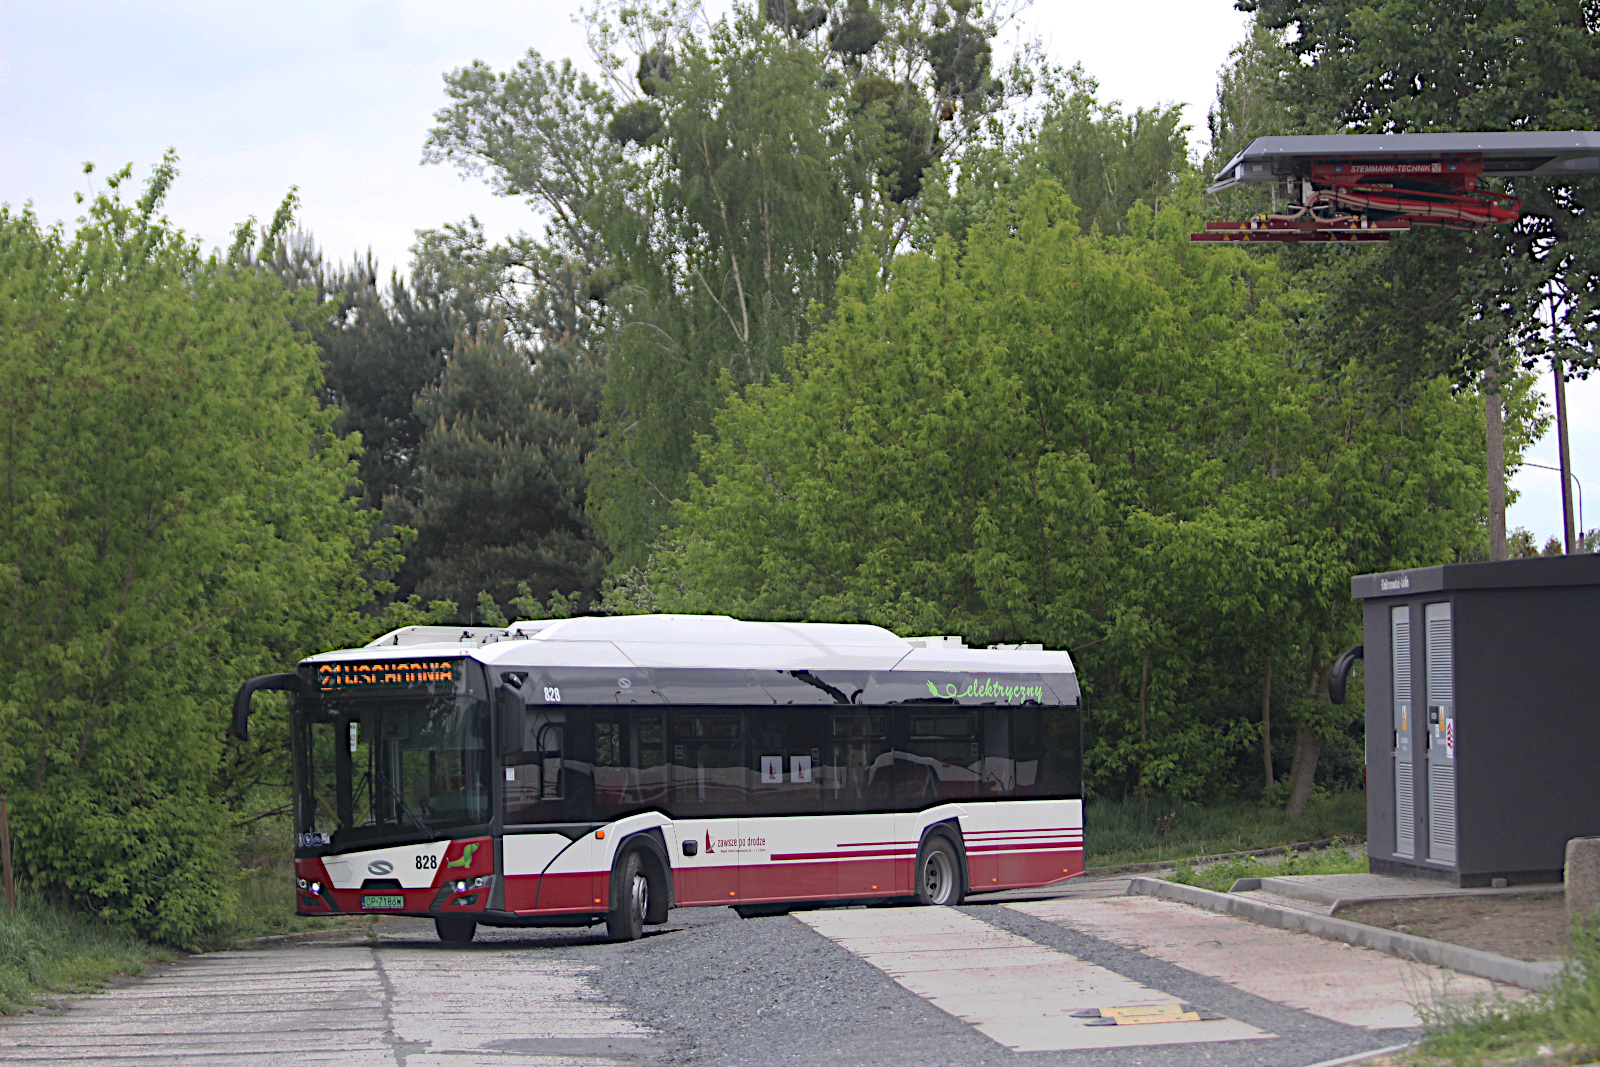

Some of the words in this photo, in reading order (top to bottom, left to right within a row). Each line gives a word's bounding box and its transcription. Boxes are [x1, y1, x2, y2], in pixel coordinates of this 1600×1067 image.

[1350, 164, 1431, 173] STEMMANN-TECHNIK
[319, 664, 342, 691] 21
[543, 686, 561, 702] 828
[966, 677, 1043, 704] elektryczny
[717, 839, 738, 848] zawsze
[738, 838, 746, 849] po
[747, 836, 766, 847] drodze
[415, 855, 437, 869] 828
